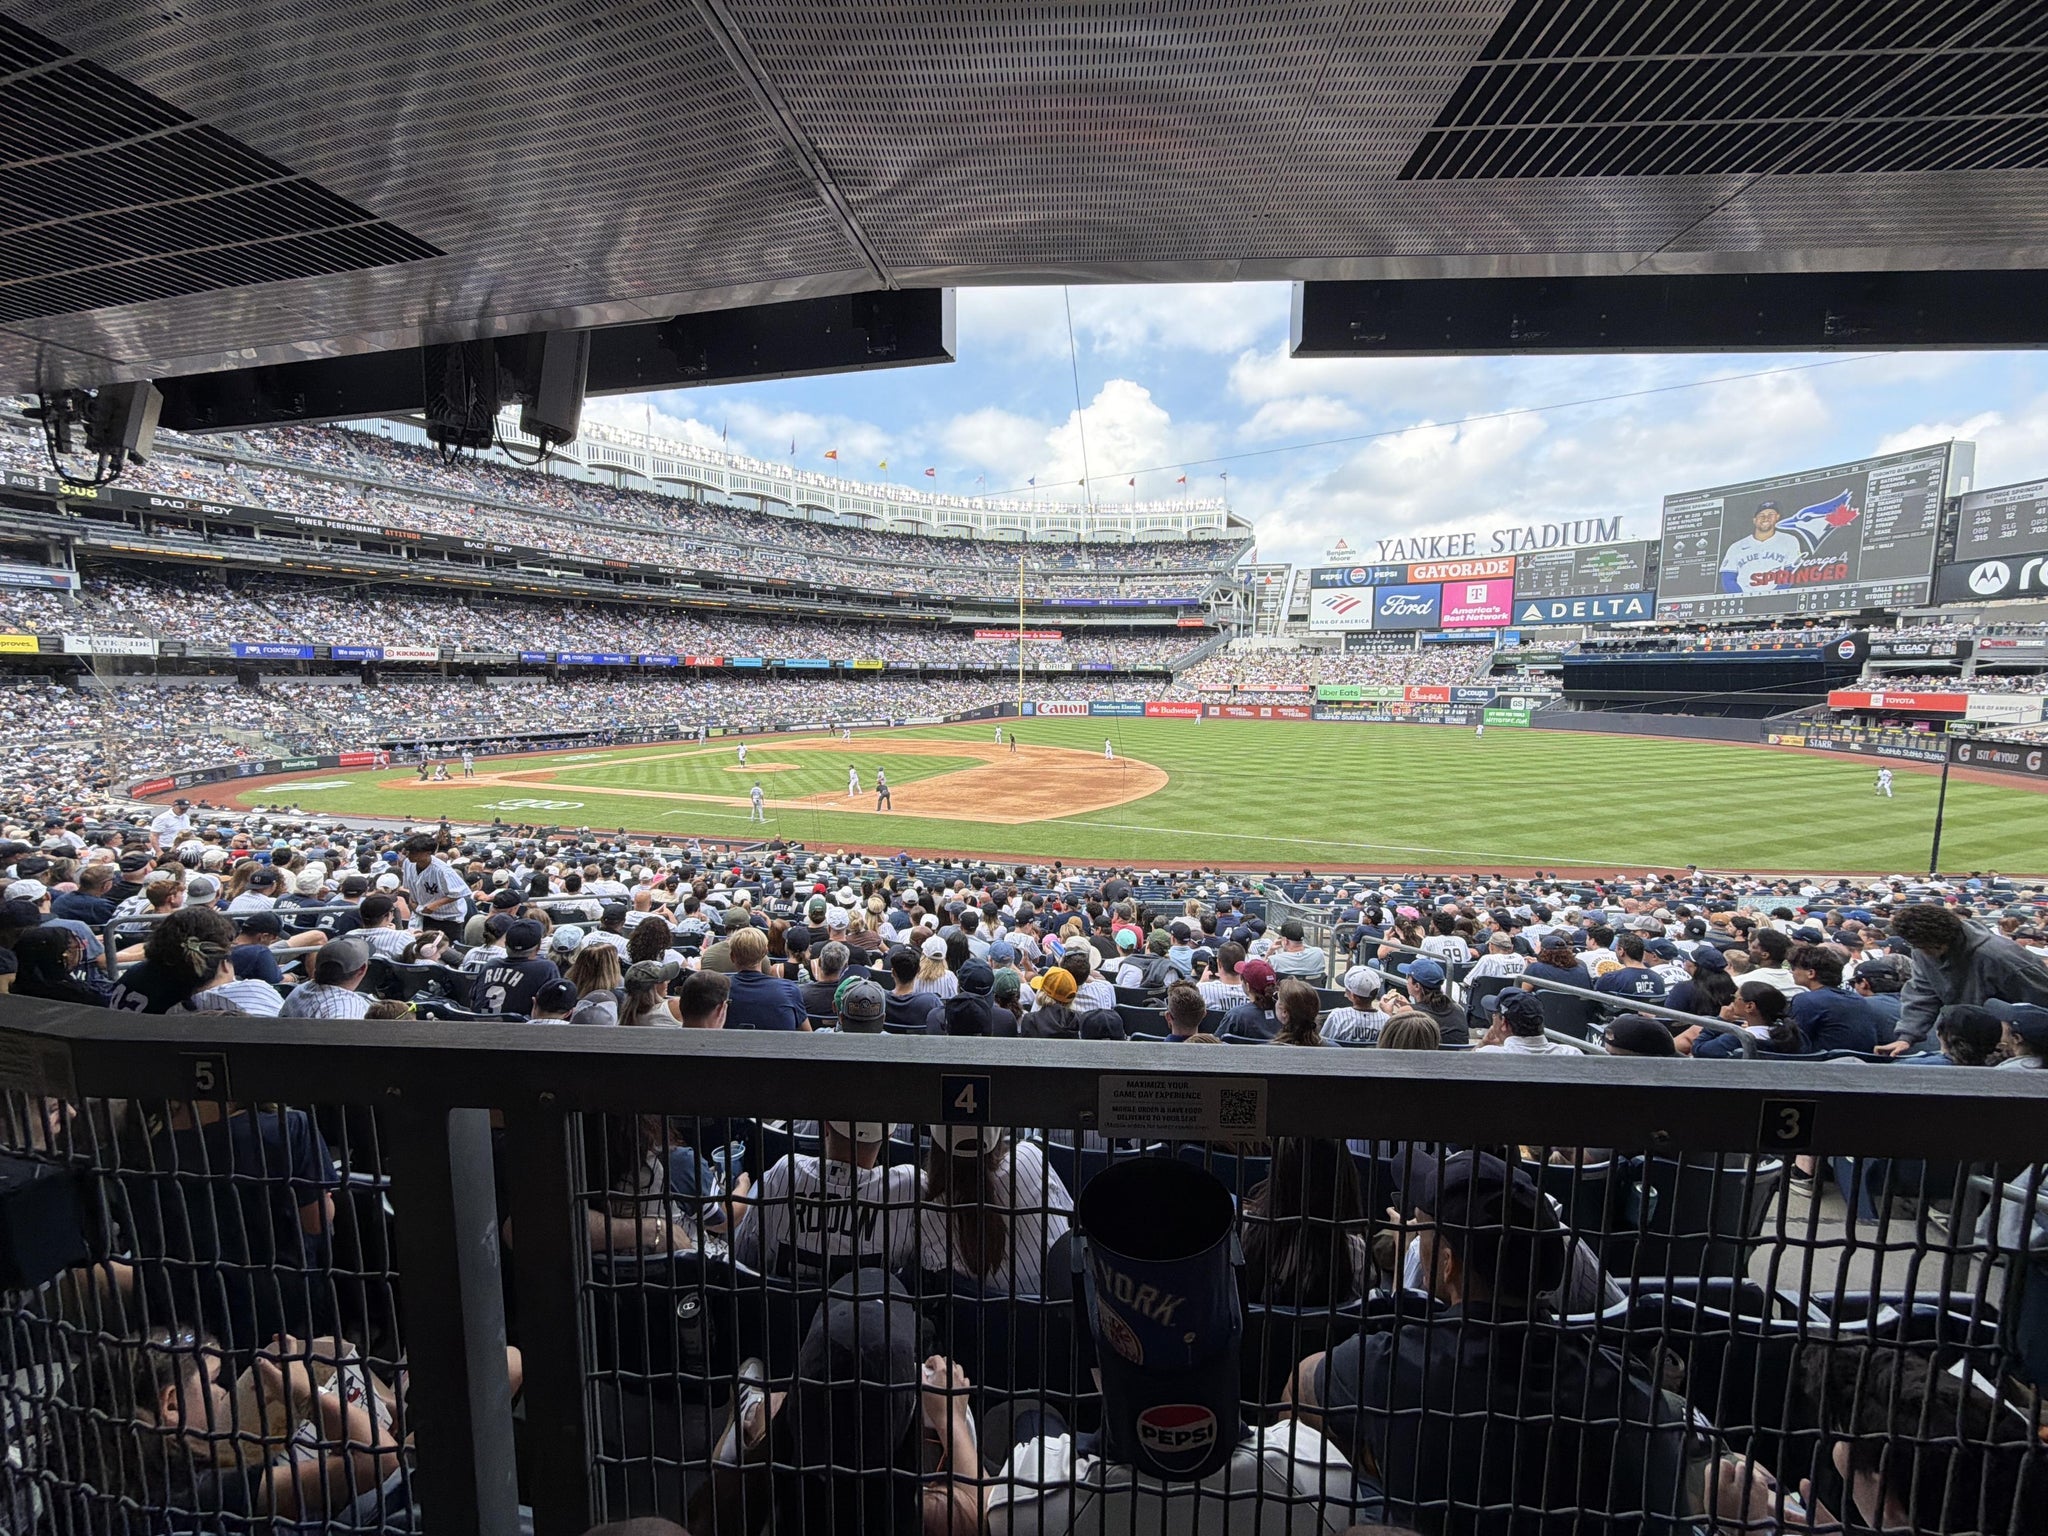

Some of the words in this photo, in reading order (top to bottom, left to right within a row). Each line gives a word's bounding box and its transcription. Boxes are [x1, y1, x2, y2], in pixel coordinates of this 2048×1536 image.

[1896, 466, 1911, 474] BLUE
[11, 475, 35, 487] ABS
[58, 482, 98, 498] 3:08
[1986, 491, 2013, 500] GEORGE
[2014, 485, 2044, 496] SPRINGER
[2008, 494, 2034, 502] SEASON
[151, 497, 184, 509] BAD
[202, 505, 233, 516] BOY
[295, 516, 324, 527] POWER.
[384, 529, 421, 540] ATTITUDE
[1972, 517, 1992, 525] .236
[1972, 527, 1989, 535] OBP
[2030, 518, 2047, 526] OPS
[1998, 530, 2018, 539] .387
[2028, 525, 2048, 534] .702
[1376, 533, 1476, 562] YANKEE
[1491, 516, 1624, 553] STADIUM
[1738, 553, 1759, 568] BLUE
[1762, 551, 1786, 564] JAYS
[1792, 552, 1838, 573] George
[1838, 551, 1848, 563] 4
[1414, 559, 1509, 579] GATORADE
[1750, 564, 1848, 586] SPRINGER
[1865, 592, 1892, 600] STRIKES
[1380, 595, 1434, 616] Ford
[1551, 598, 1644, 618] DELTA
[1466, 611, 1509, 621] Network
[263, 646, 301, 655] roadway
[1466, 690, 1488, 698] coupa
[1037, 702, 1087, 715] Canon
[1161, 707, 1199, 715] Budweiser
[1809, 739, 1833, 748] STARR
[1877, 746, 1901, 756] StubHub
[1902, 749, 1923, 759] StubHub
[1924, 752, 1945, 762] StubHub
[1958, 744, 1971, 762] G
[2026, 751, 2042, 771] G
[1443, 948, 1462, 963] 99
[484, 967, 524, 987] RUTH
[1502, 964, 1523, 975] JETER
[1635, 982, 1655, 993] RICE
[481, 986, 506, 1014] 3
[1352, 1027, 1380, 1041] JUDG
[195, 1062, 215, 1091] 5
[1126, 1080, 1166, 1089] MAXIMIZE
[954, 1083, 977, 1114] 4
[1113, 1090, 1137, 1098] GAME
[1138, 1091, 1154, 1099] DAY
[1155, 1091, 1202, 1100] EXPERIENCE
[1777, 1108, 1800, 1139] 3
[1142, 1423, 1213, 1445] PEPSI
